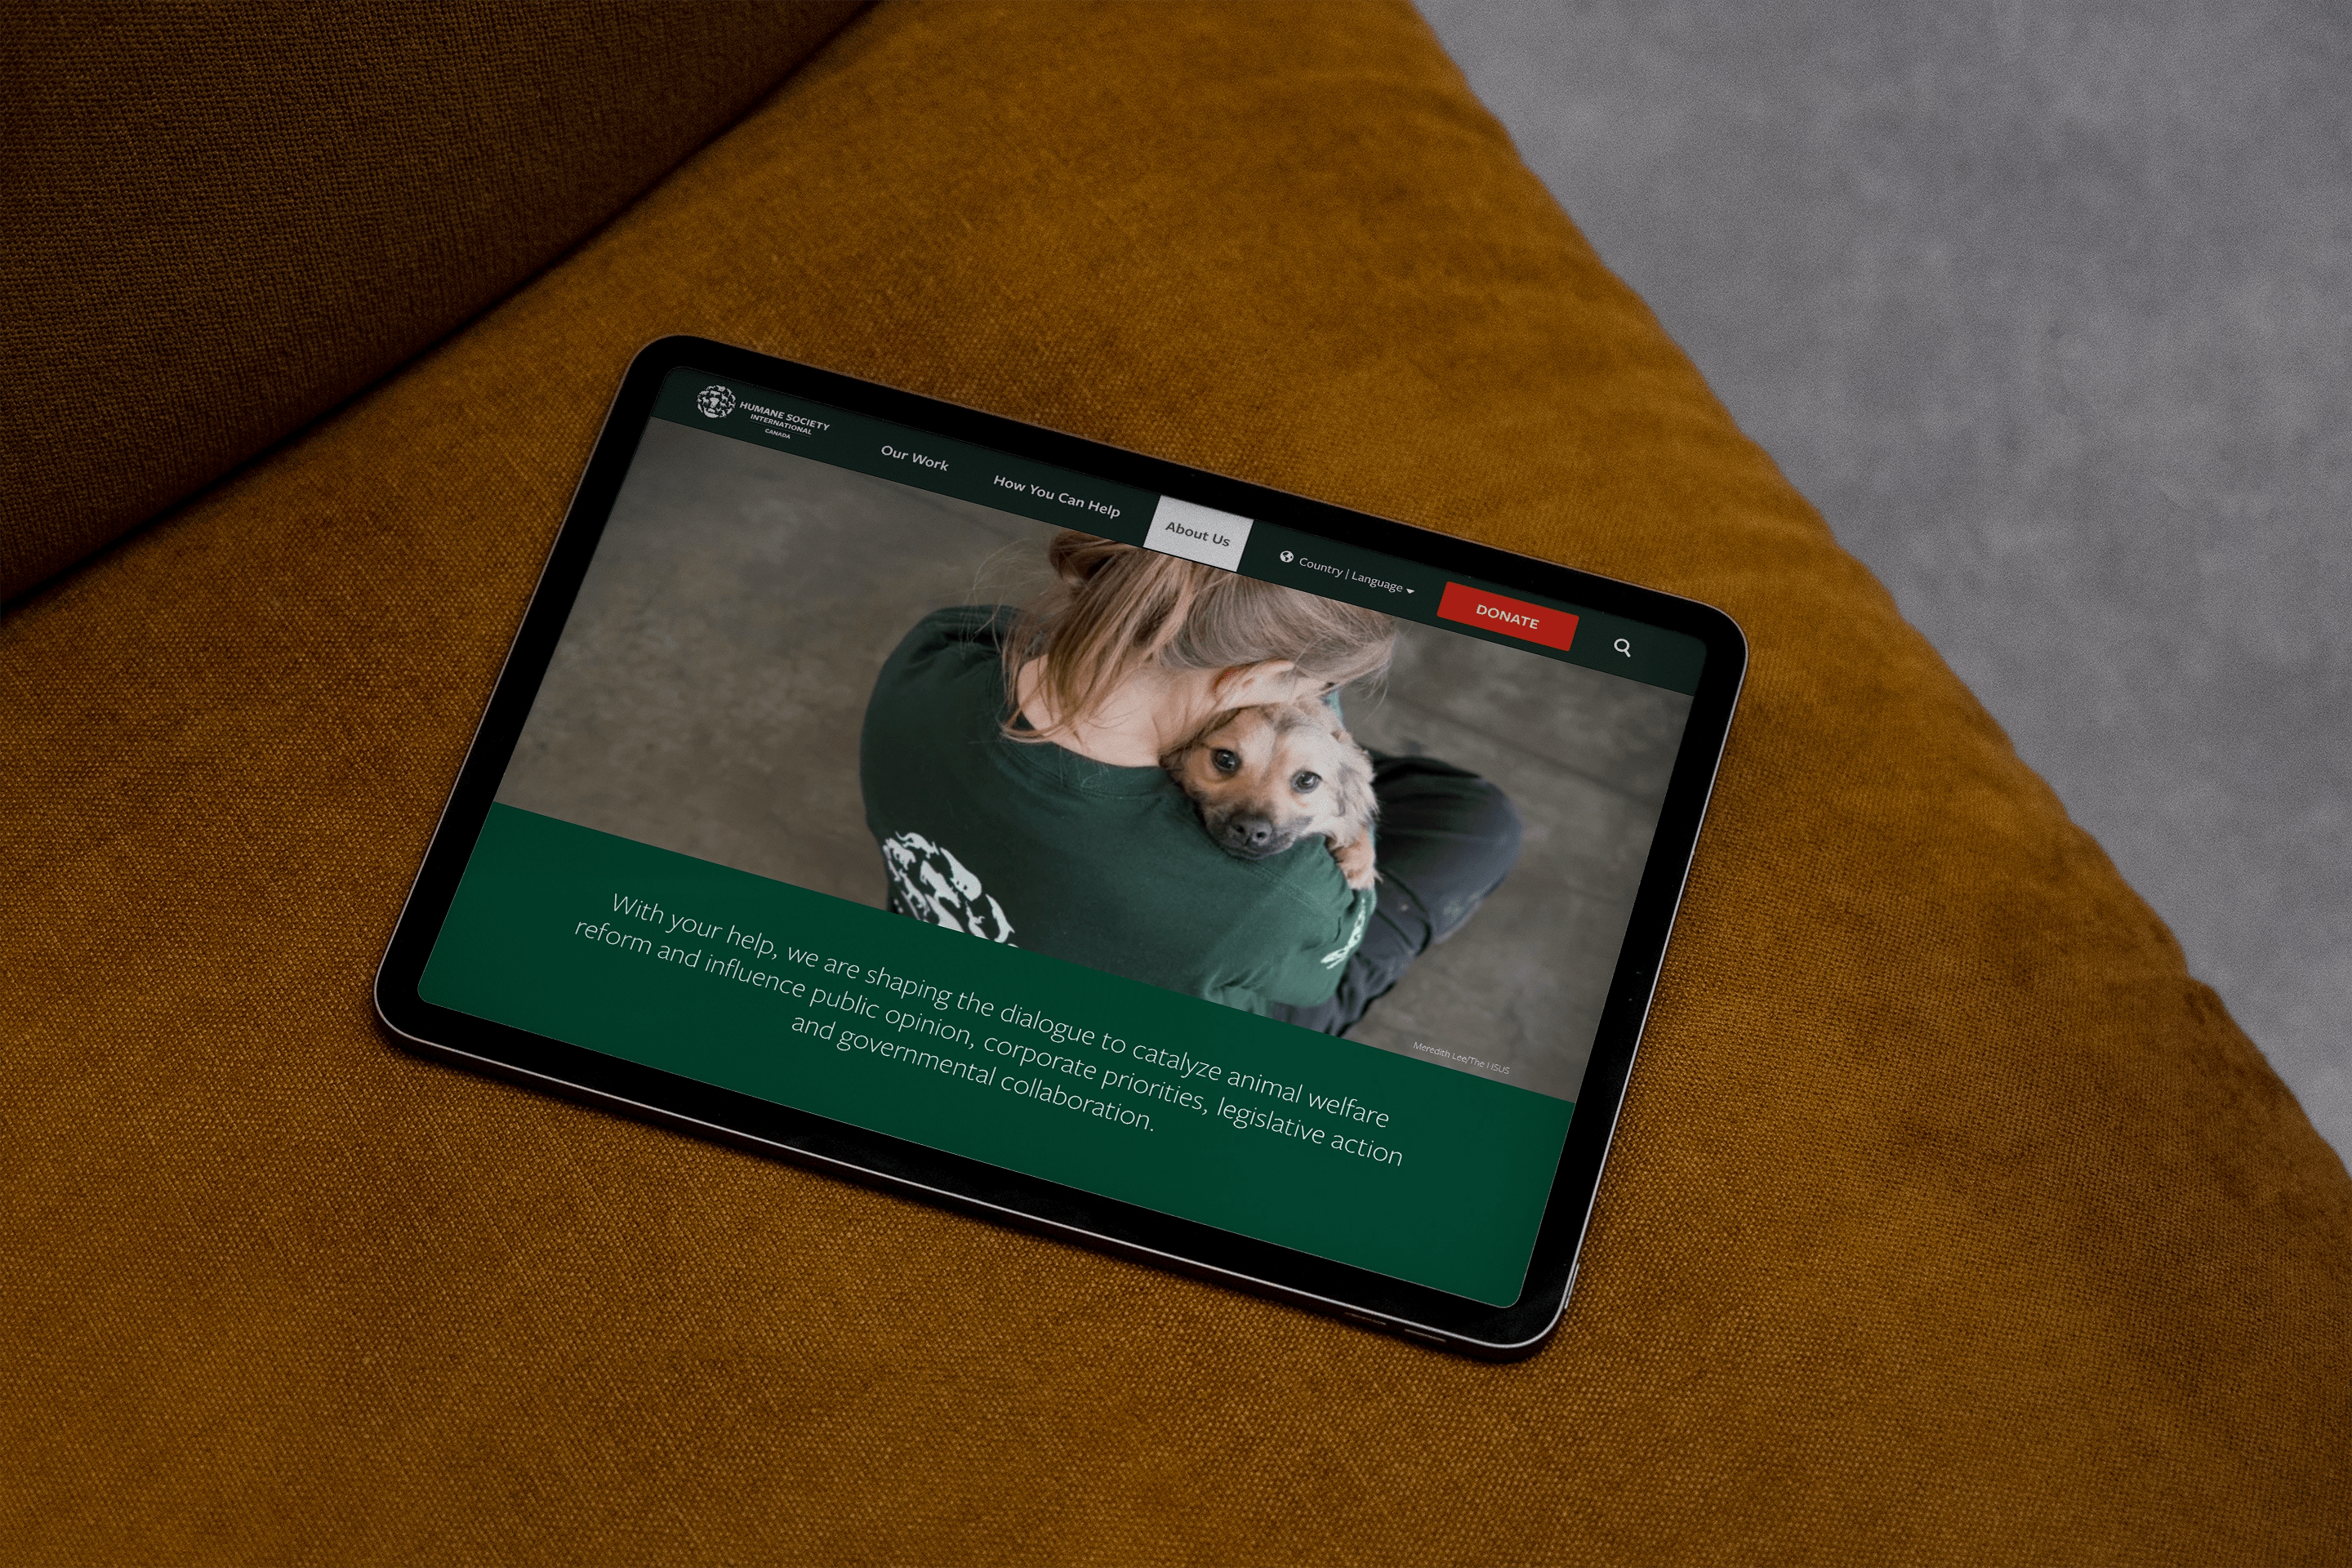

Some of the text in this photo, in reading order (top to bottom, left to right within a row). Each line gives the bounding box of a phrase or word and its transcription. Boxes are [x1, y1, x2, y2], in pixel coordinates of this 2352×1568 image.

[740, 402, 830, 430] HUMANE SOCIETY
[751, 414, 811, 434] INTERNATIONAL
[765, 429, 790, 439] CANADA
[881, 446, 949, 471] Our Work
[994, 475, 1120, 519] How You Can Help
[1165, 522, 1230, 546] About Us
[1299, 558, 1343, 577] Country
[1352, 572, 1402, 592] Language
[1477, 604, 1539, 629] DONATE
[614, 893, 1388, 1127] With your help, we are shaping the dialogue to catalyze animal welfare
[575, 922, 1401, 1166] reform and influence public opinion, corporate priorities, legislative action
[1414, 1042, 1450, 1058] Meredith
[792, 1018, 1153, 1131] and governmental collaboration.
